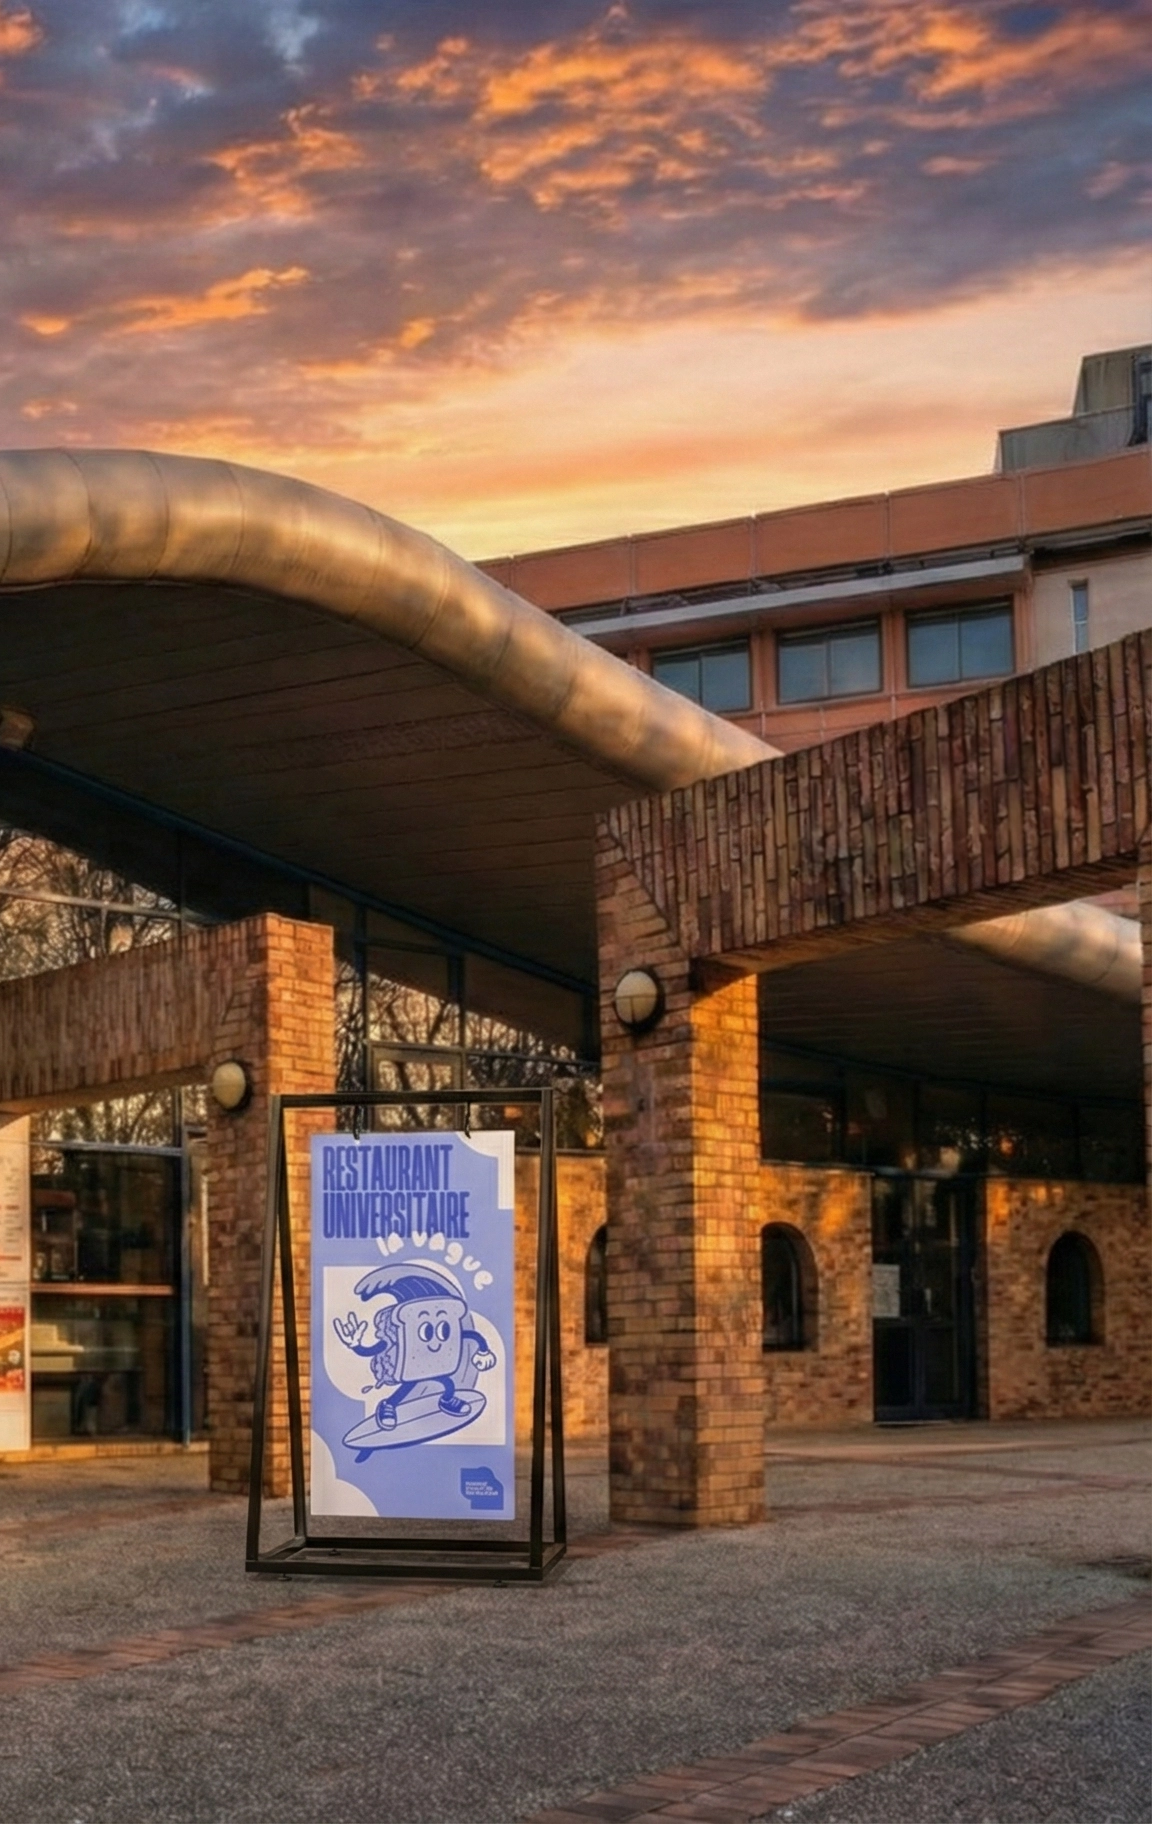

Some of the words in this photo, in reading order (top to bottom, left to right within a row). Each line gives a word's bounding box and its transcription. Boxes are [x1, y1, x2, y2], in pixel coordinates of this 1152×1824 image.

[323, 1145, 453, 1191] RESTAURANT
[323, 1191, 470, 1239] UNIVERSITAIRE
[376, 1231, 404, 1257] la
[411, 1230, 493, 1291] vague
